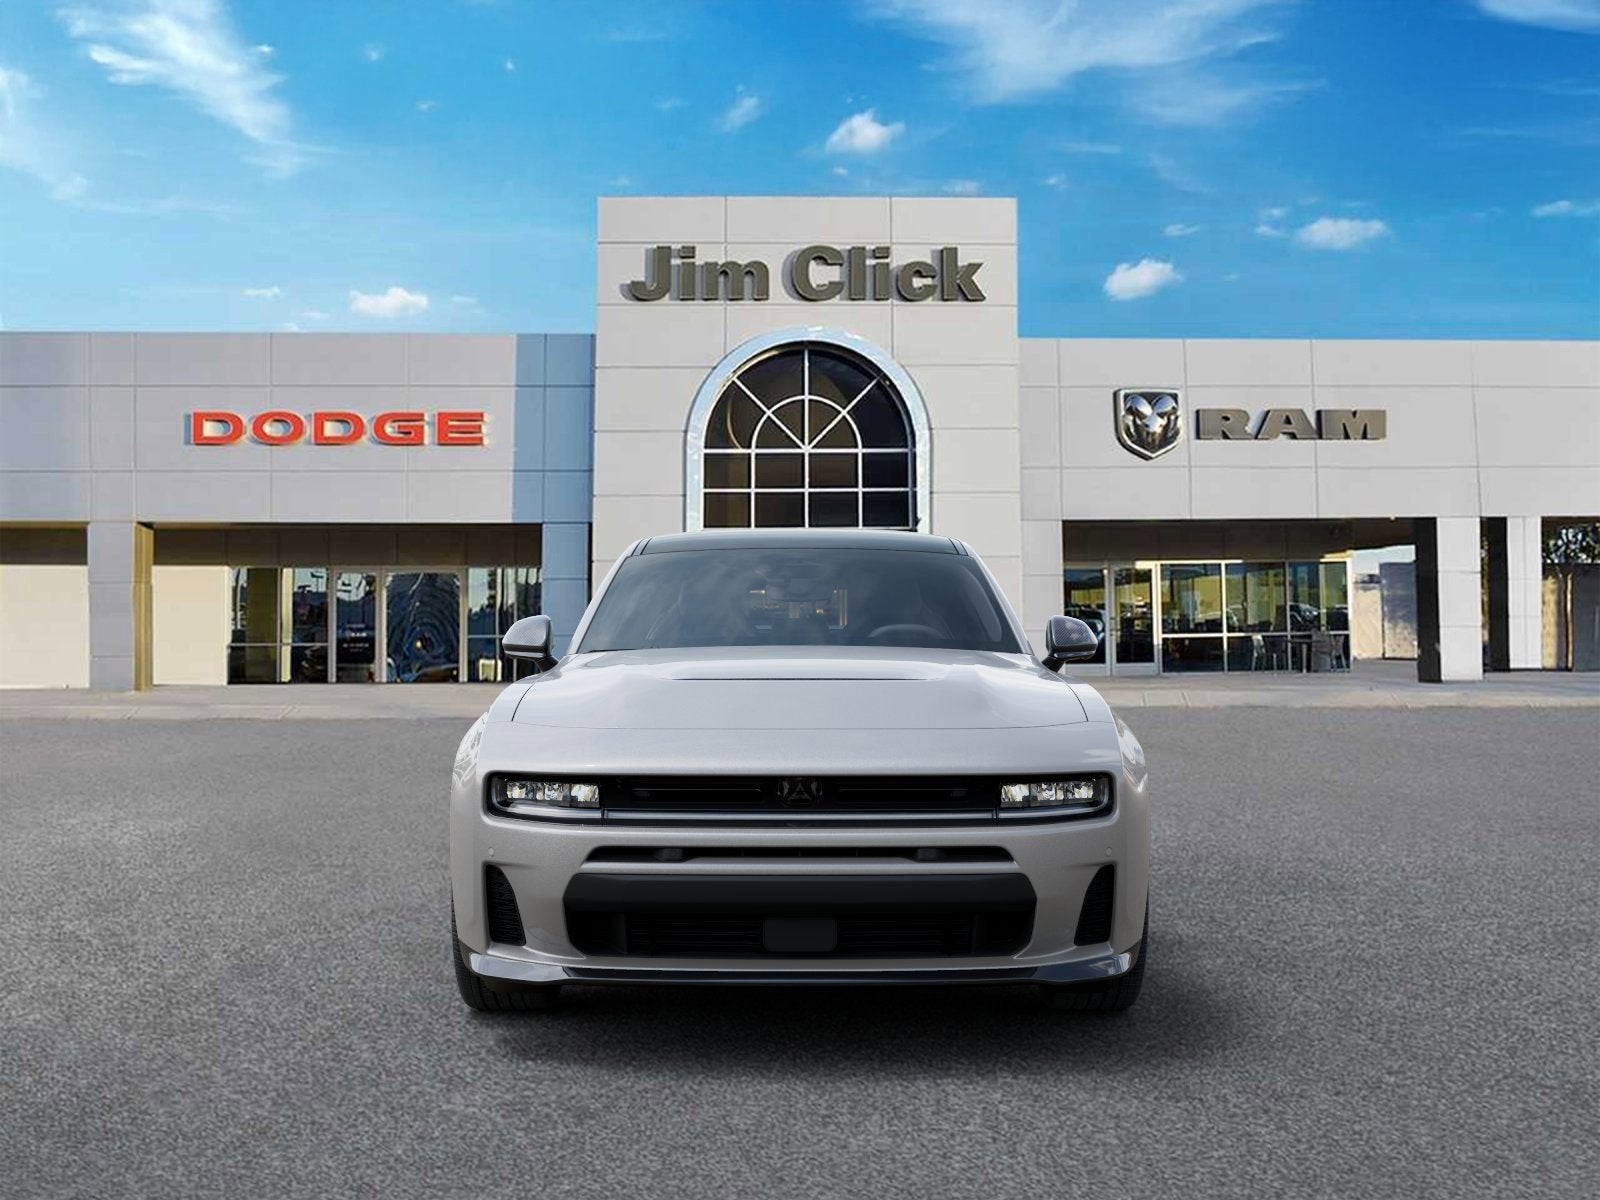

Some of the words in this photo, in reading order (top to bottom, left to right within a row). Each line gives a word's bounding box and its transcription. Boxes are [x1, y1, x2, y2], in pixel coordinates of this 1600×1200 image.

[627, 245, 770, 301] Jim
[790, 245, 986, 301] Click
[190, 410, 487, 446] DODGE
[1195, 408, 1387, 440] RAM
